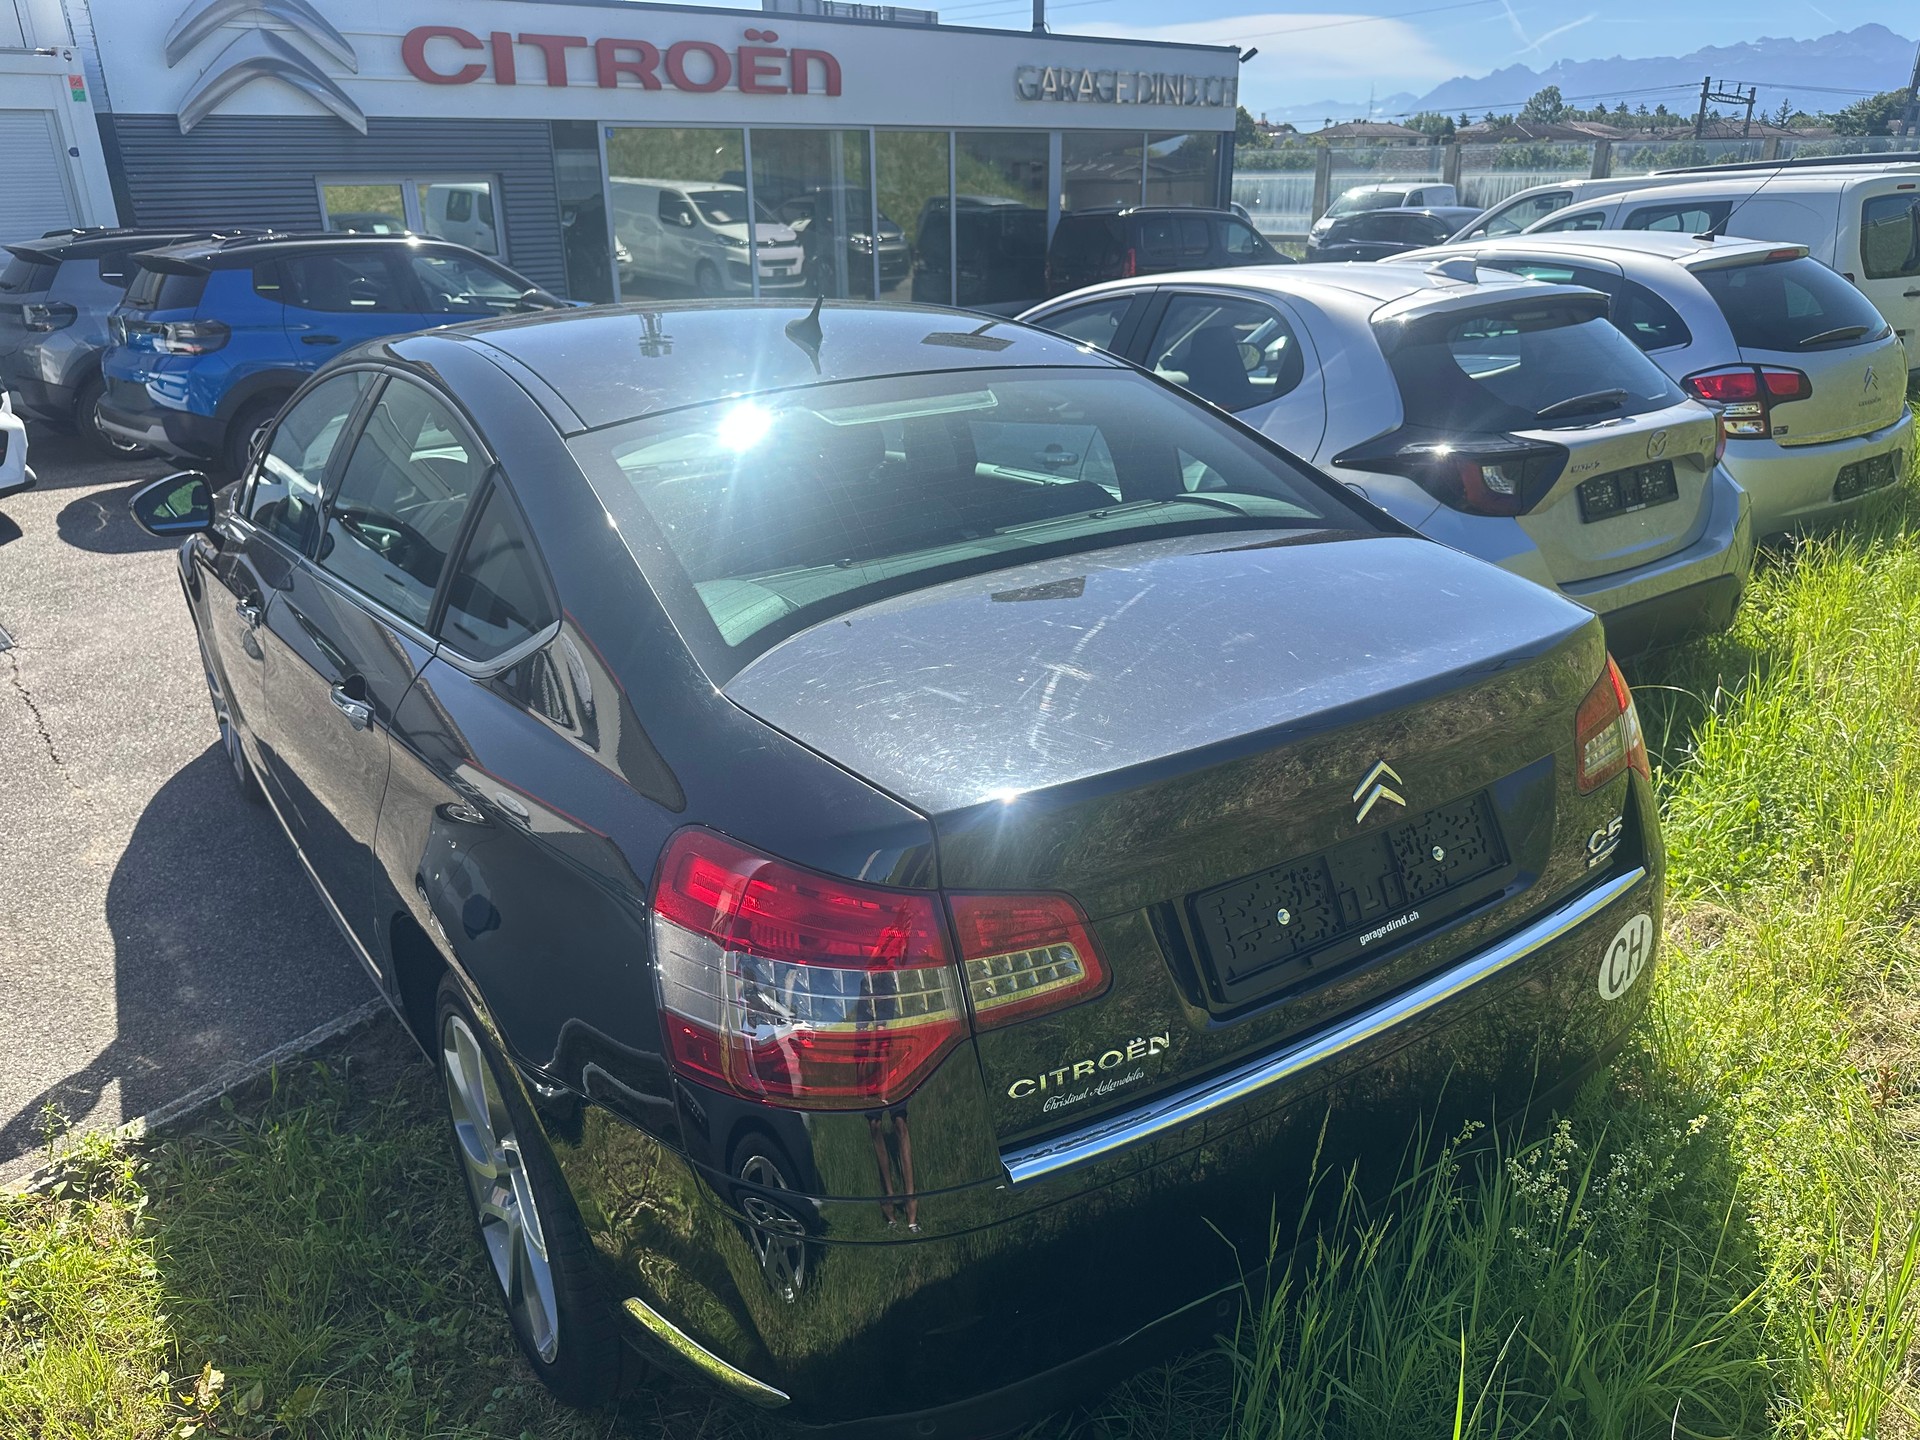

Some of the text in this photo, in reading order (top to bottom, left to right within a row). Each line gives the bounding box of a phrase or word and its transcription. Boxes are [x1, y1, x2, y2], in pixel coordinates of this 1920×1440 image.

[401, 26, 842, 97] CITROËN
[1588, 816, 1623, 853] C5
[1359, 911, 1420, 946] garagedind.ch
[1608, 920, 1645, 994] CH
[1007, 1031, 1170, 1099] CITROËN
[1089, 1067, 1145, 1096] Automobiles
